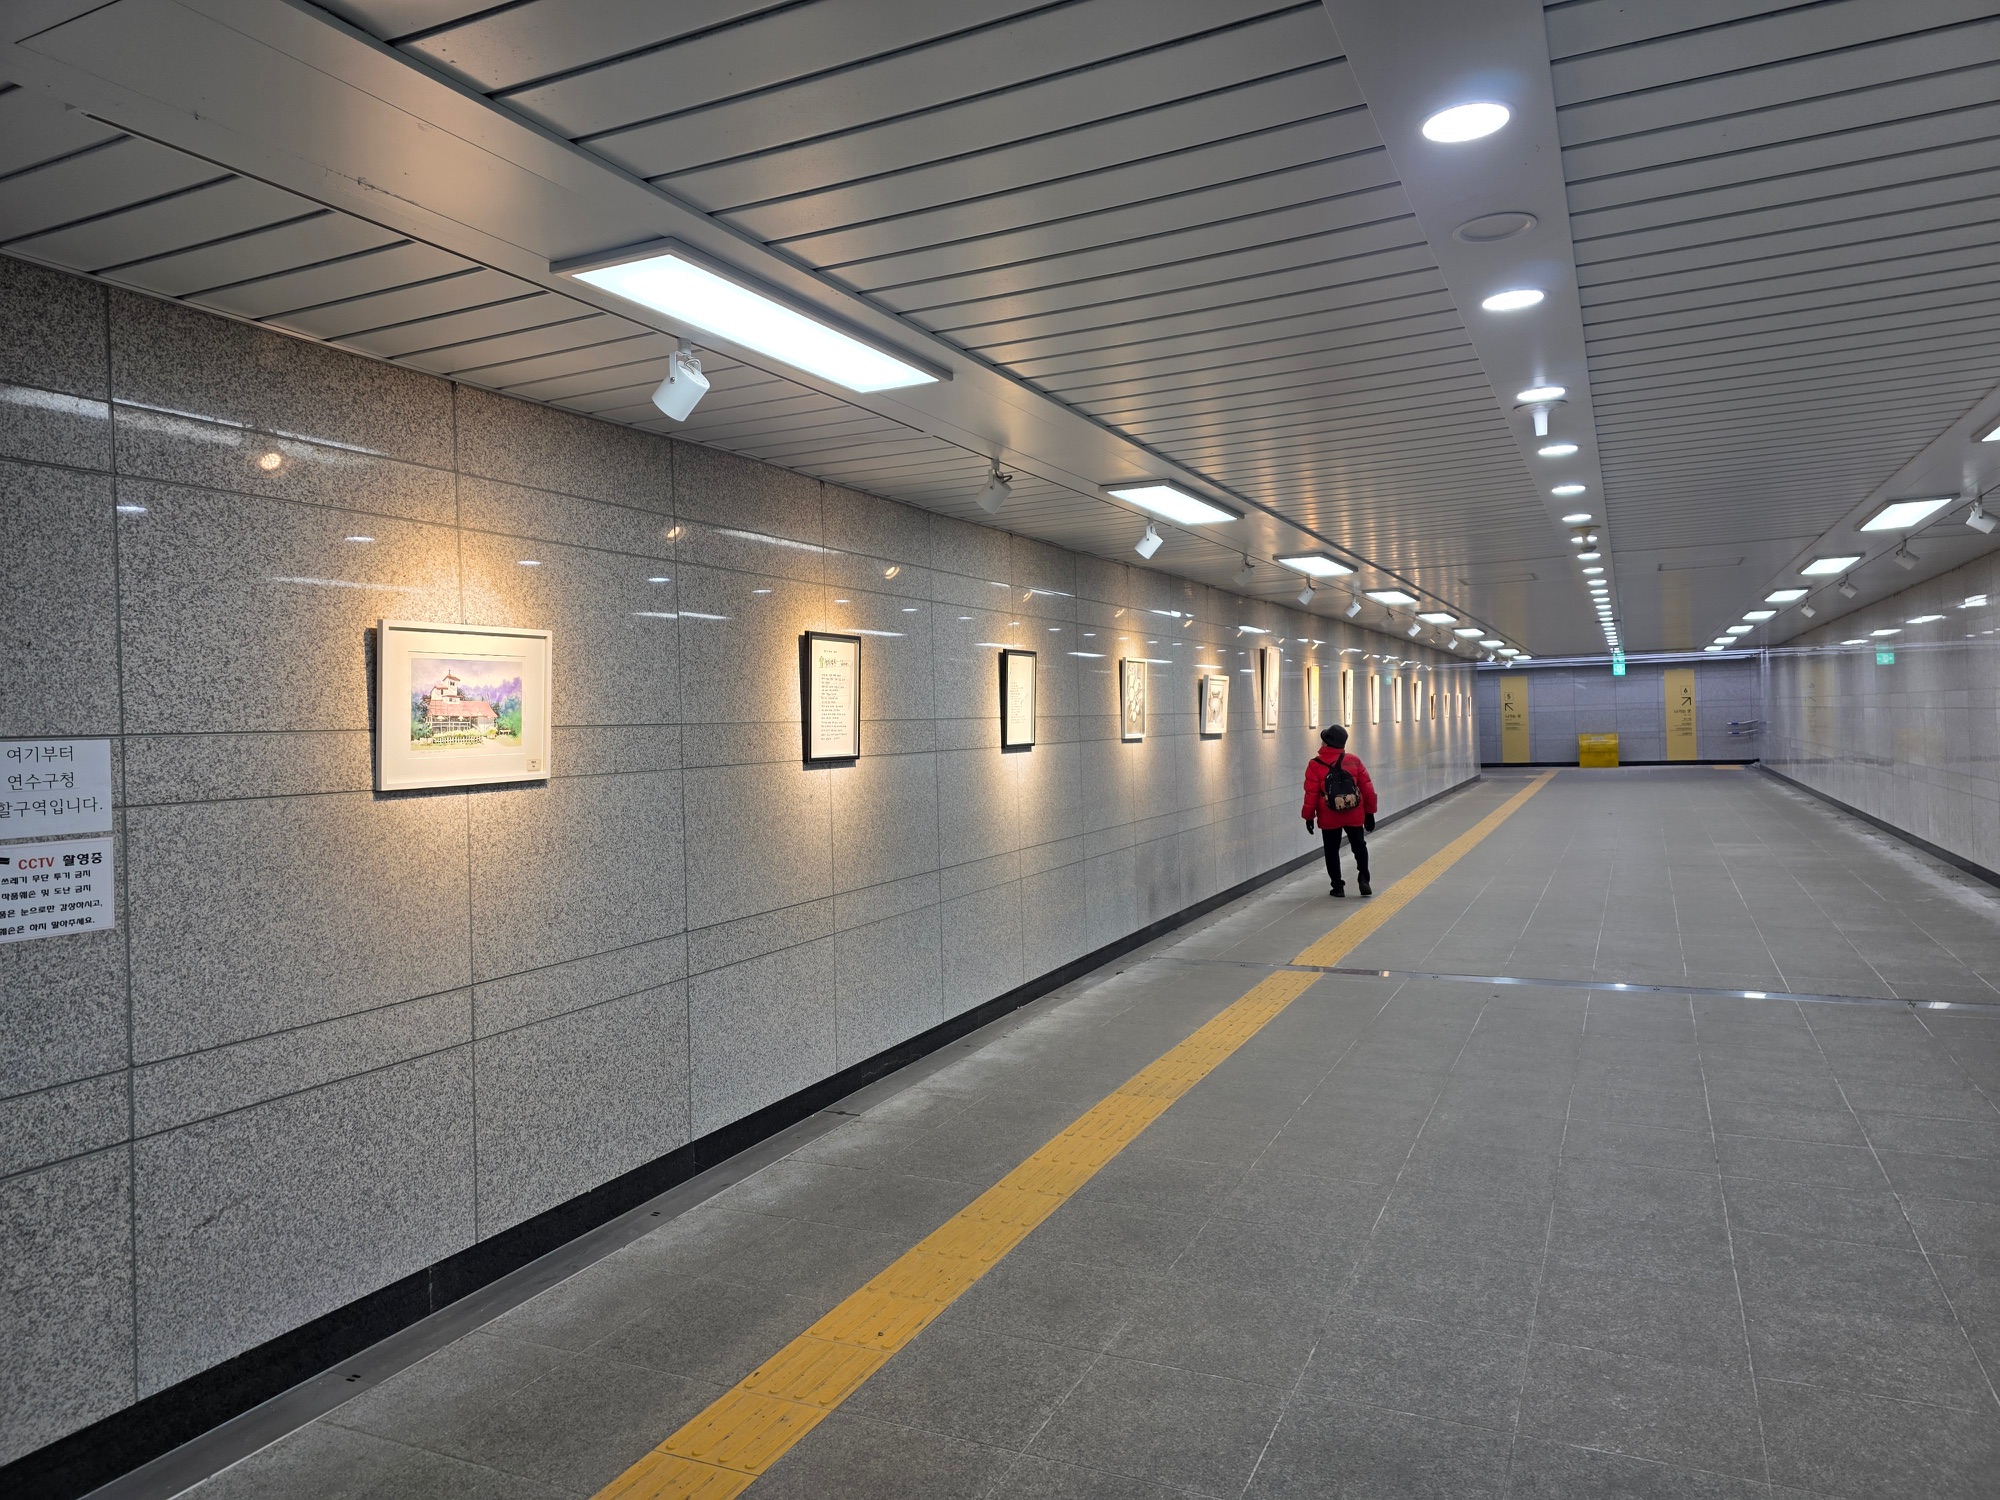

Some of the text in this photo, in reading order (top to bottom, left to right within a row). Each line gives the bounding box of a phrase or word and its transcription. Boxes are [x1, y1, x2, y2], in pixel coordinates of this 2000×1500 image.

[7, 745, 73, 763] 여기부터
[8, 772, 74, 790] 연수구청
[18, 852, 102, 870] CCTV 촬영중
[1, 870, 91, 885] 쓰레기 무단 투기 금지
[41, 889, 50, 897] 및
[54, 887, 71, 895] 도난
[75, 884, 91, 893] 금지
[20, 905, 55, 916] 눈으로만
